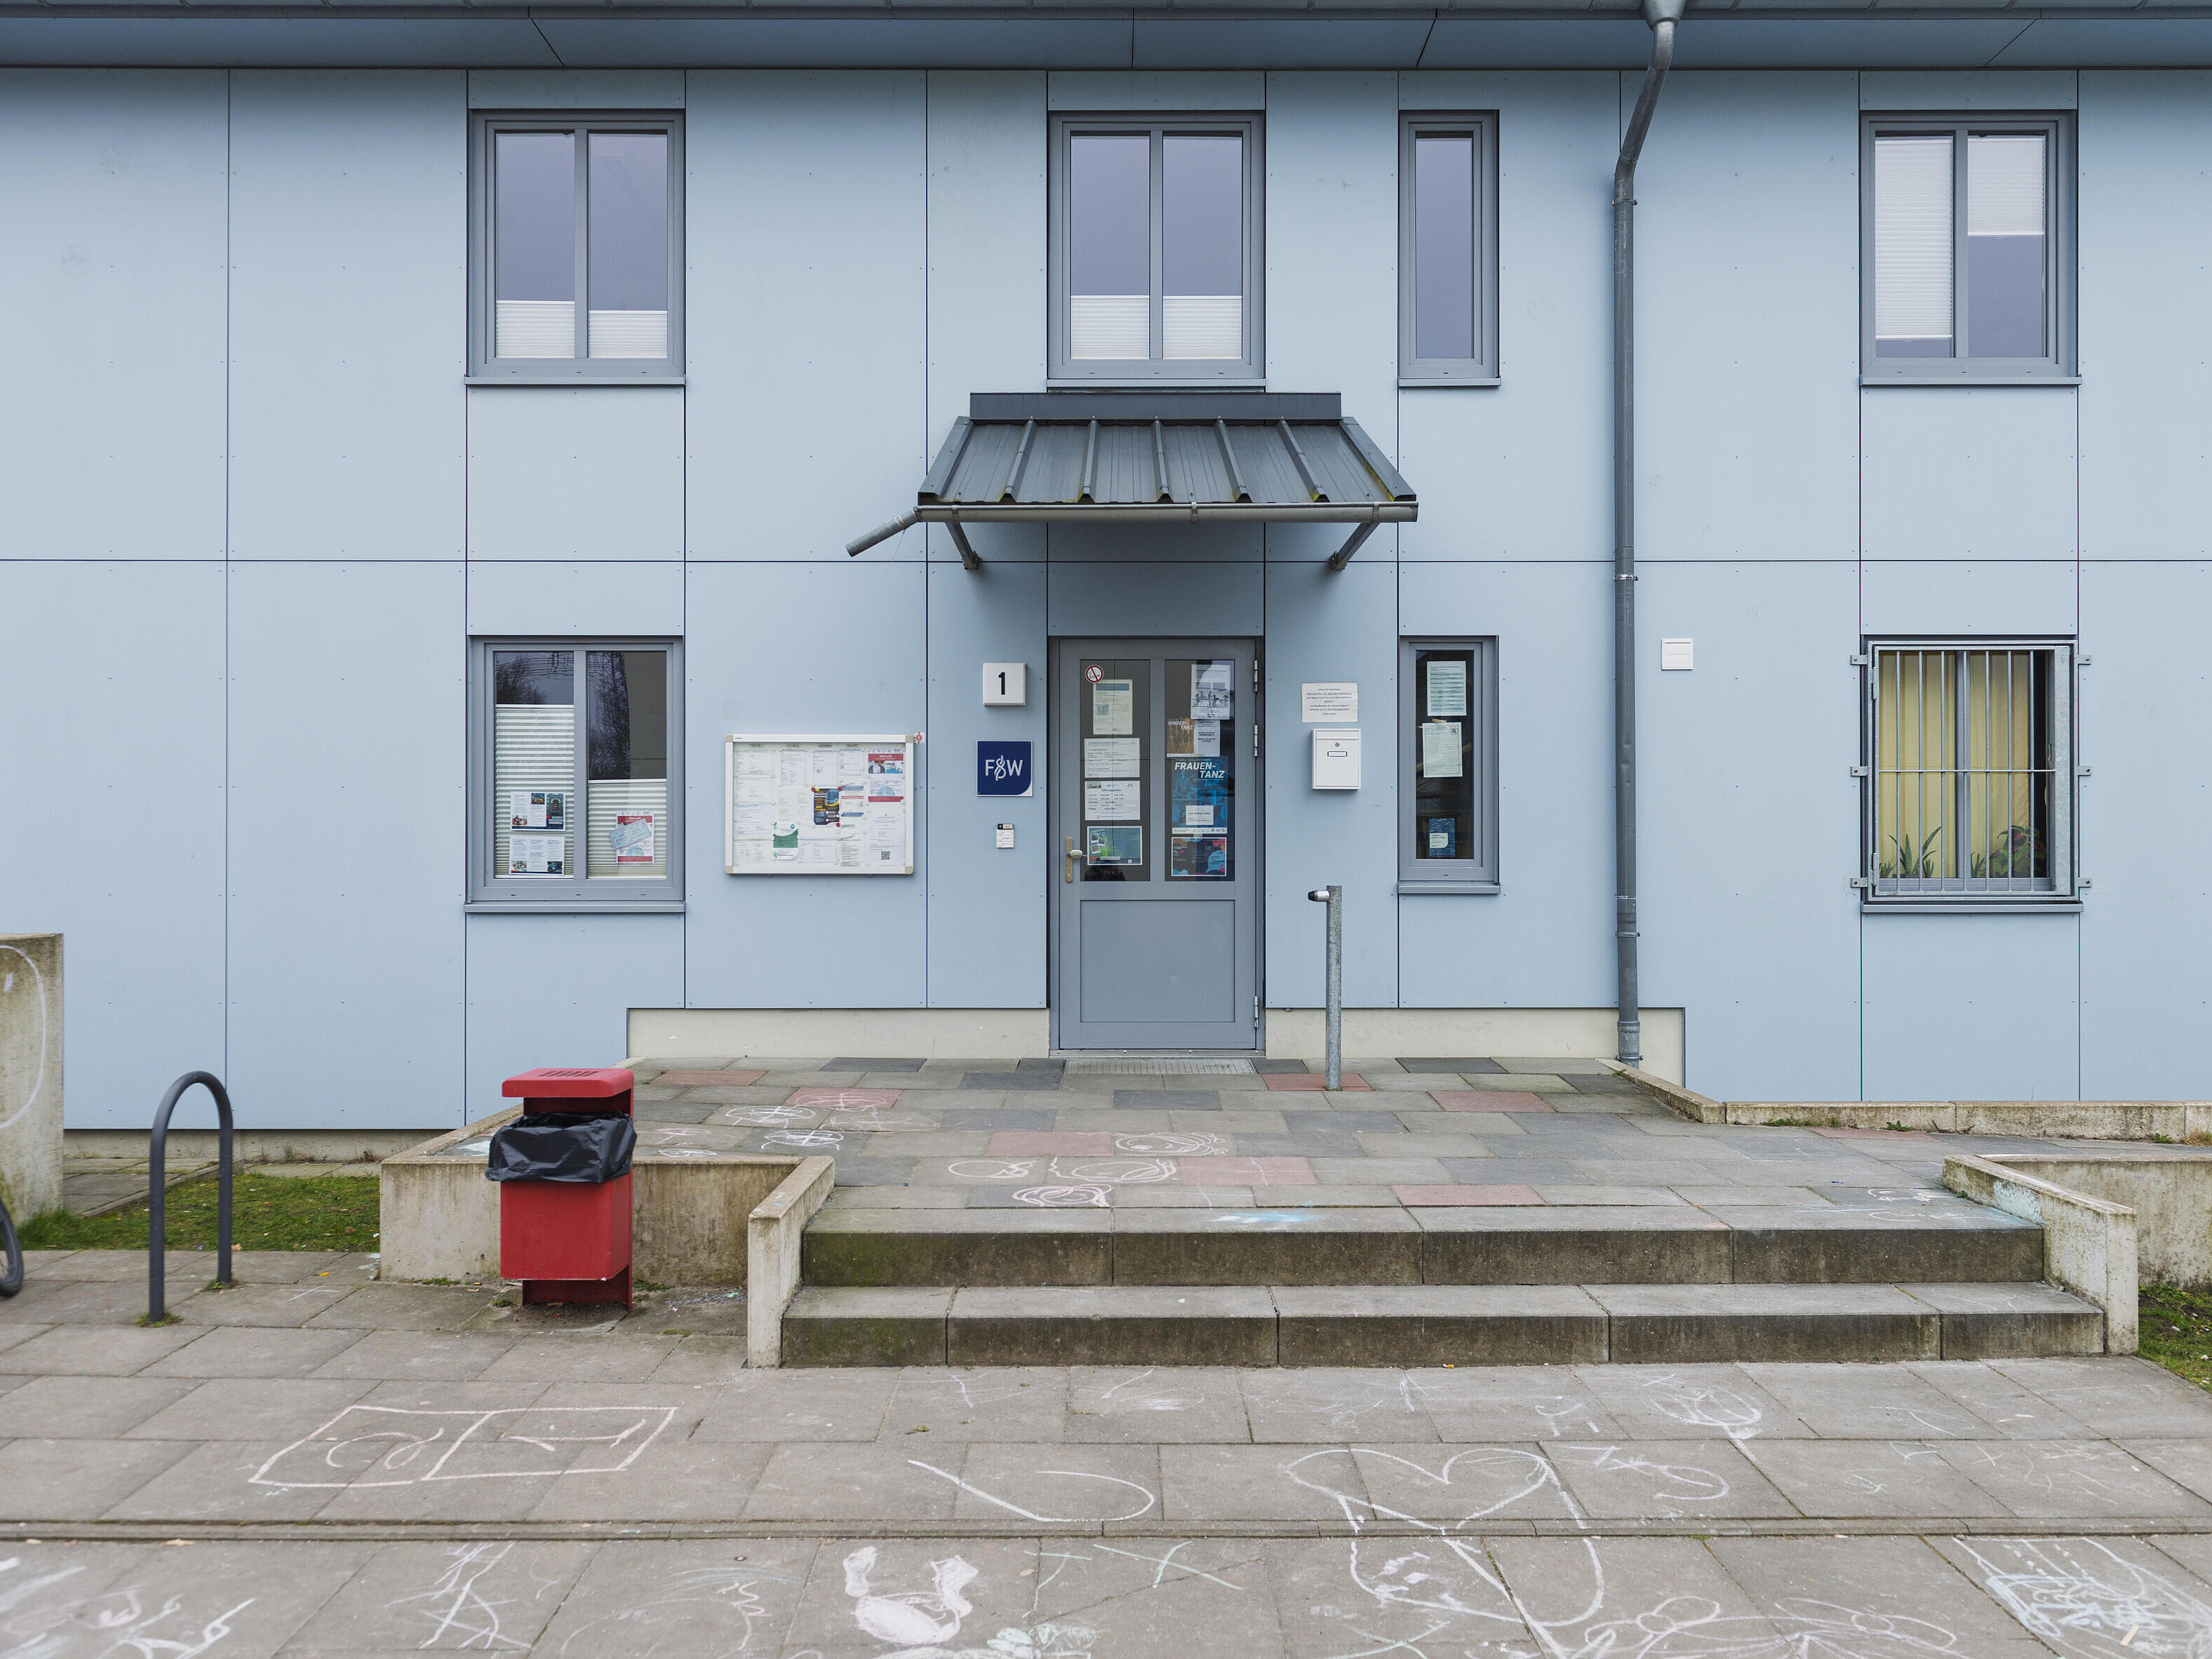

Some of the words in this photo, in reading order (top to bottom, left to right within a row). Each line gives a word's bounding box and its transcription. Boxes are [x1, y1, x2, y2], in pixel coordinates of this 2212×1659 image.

[998, 671, 1005, 695] 1
[1174, 762, 1216, 770] FRAUEN-
[1200, 770, 1225, 779] TANZ
